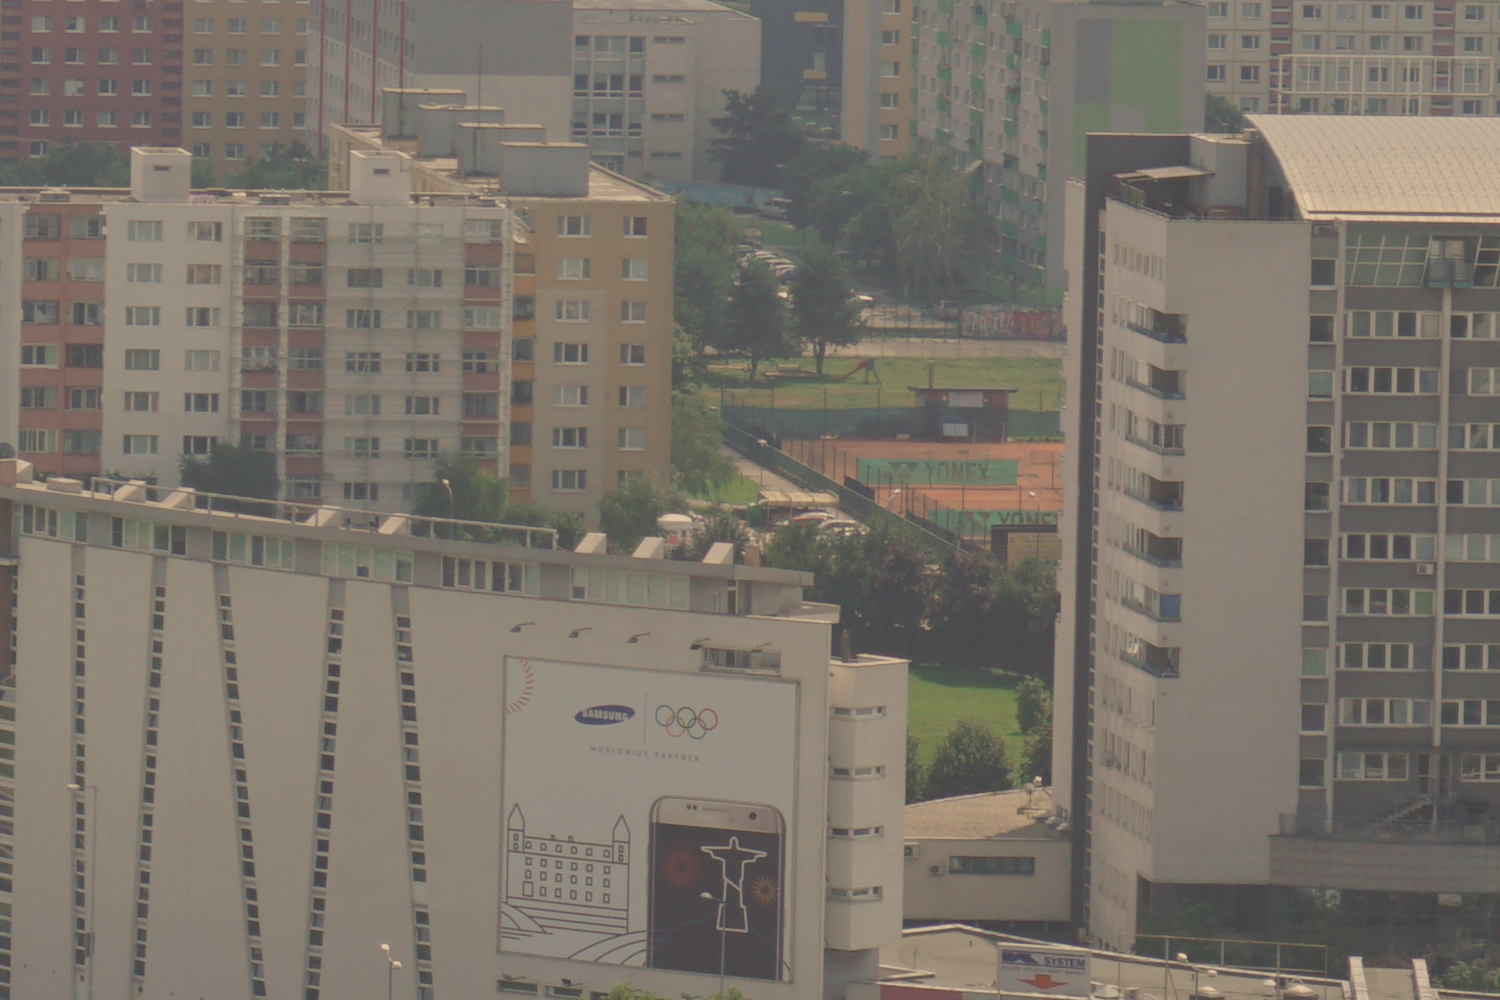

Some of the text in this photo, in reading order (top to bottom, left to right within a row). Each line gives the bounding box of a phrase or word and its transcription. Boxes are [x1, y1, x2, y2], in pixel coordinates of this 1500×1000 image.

[581, 709, 629, 722] SAMSUNG
[590, 745, 700, 762] WORLDWIDE PARTNER
[1044, 956, 1086, 968] SYSTEM
